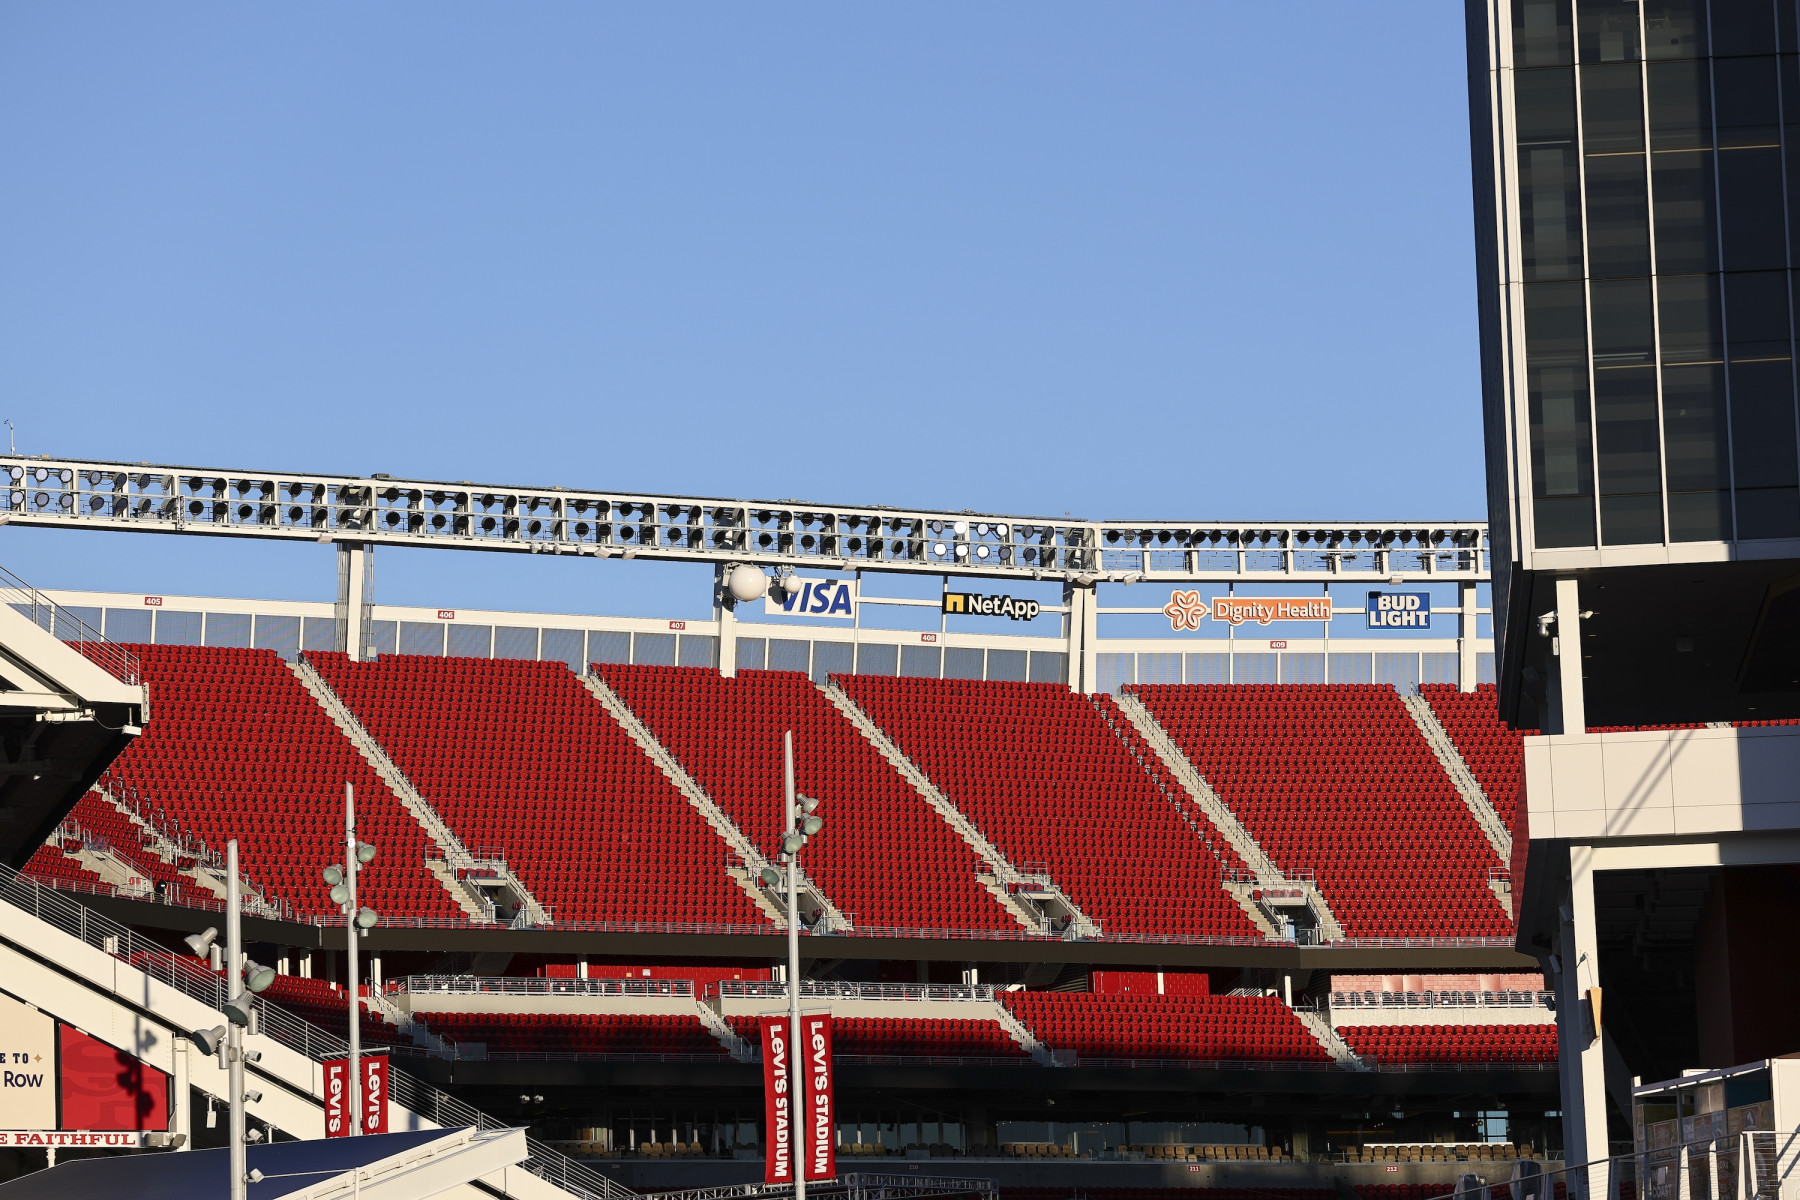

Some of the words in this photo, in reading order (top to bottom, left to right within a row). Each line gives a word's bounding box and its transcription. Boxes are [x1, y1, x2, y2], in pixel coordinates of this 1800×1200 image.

[146, 597, 161, 605] 405
[779, 583, 852, 615] VISA
[968, 595, 1040, 619] NetApp
[1377, 595, 1421, 611] BUD
[439, 611, 453, 619] 406
[1216, 601, 1275, 622] Dignity
[1277, 601, 1330, 618] Health
[1369, 610, 1429, 626] LIGHT
[671, 621, 685, 629] 407
[12, 1052, 29, 1064] TO
[14, 1133, 136, 1146] FAITHFUL
[774, 1097, 789, 1177] STADIUM
[814, 1094, 829, 1174] STADIUM
